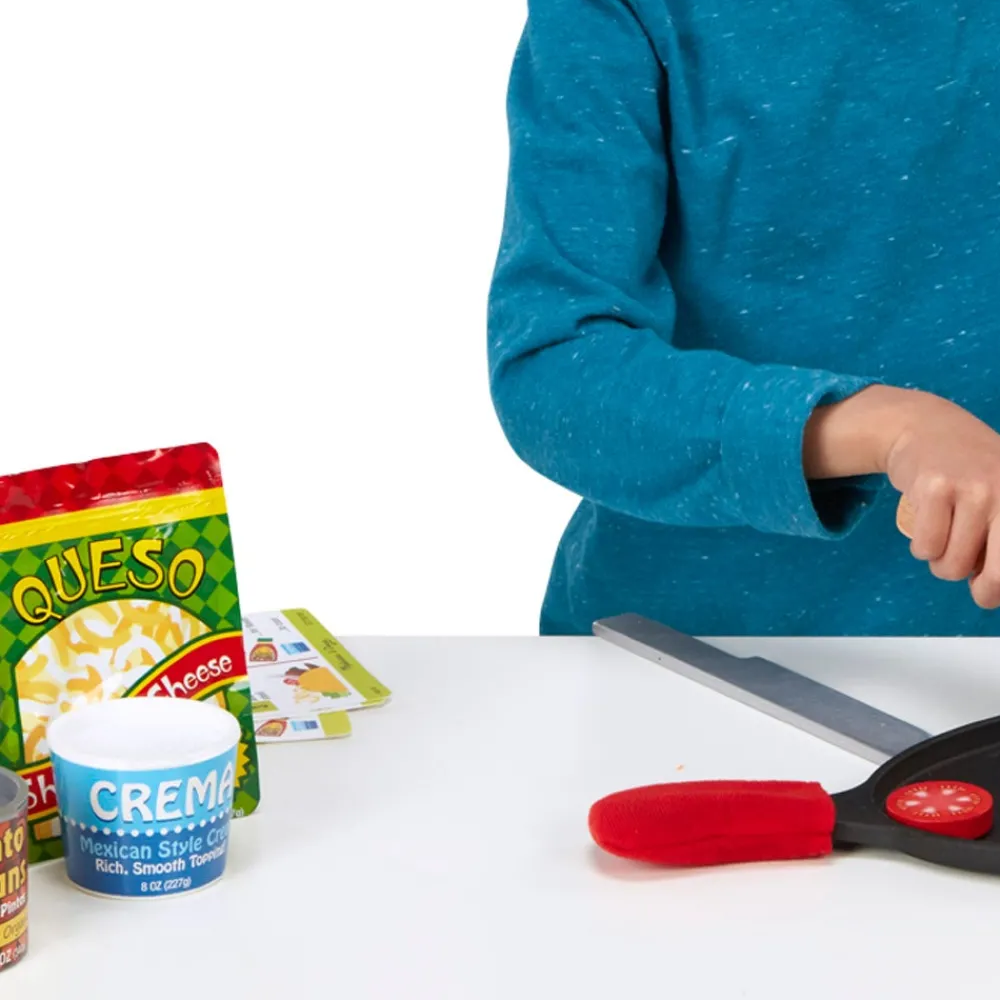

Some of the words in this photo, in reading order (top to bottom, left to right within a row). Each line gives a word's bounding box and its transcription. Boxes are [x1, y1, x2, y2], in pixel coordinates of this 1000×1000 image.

[11, 537, 206, 625] QUESO
[89, 761, 234, 823] CREMA
[80, 834, 151, 860] Mexican
[158, 836, 203, 860] Style
[132, 860, 186, 877] Smooth
[140, 882, 148, 893] 8
[149, 880, 163, 892] OZ
[163, 876, 193, 892] (227g)
